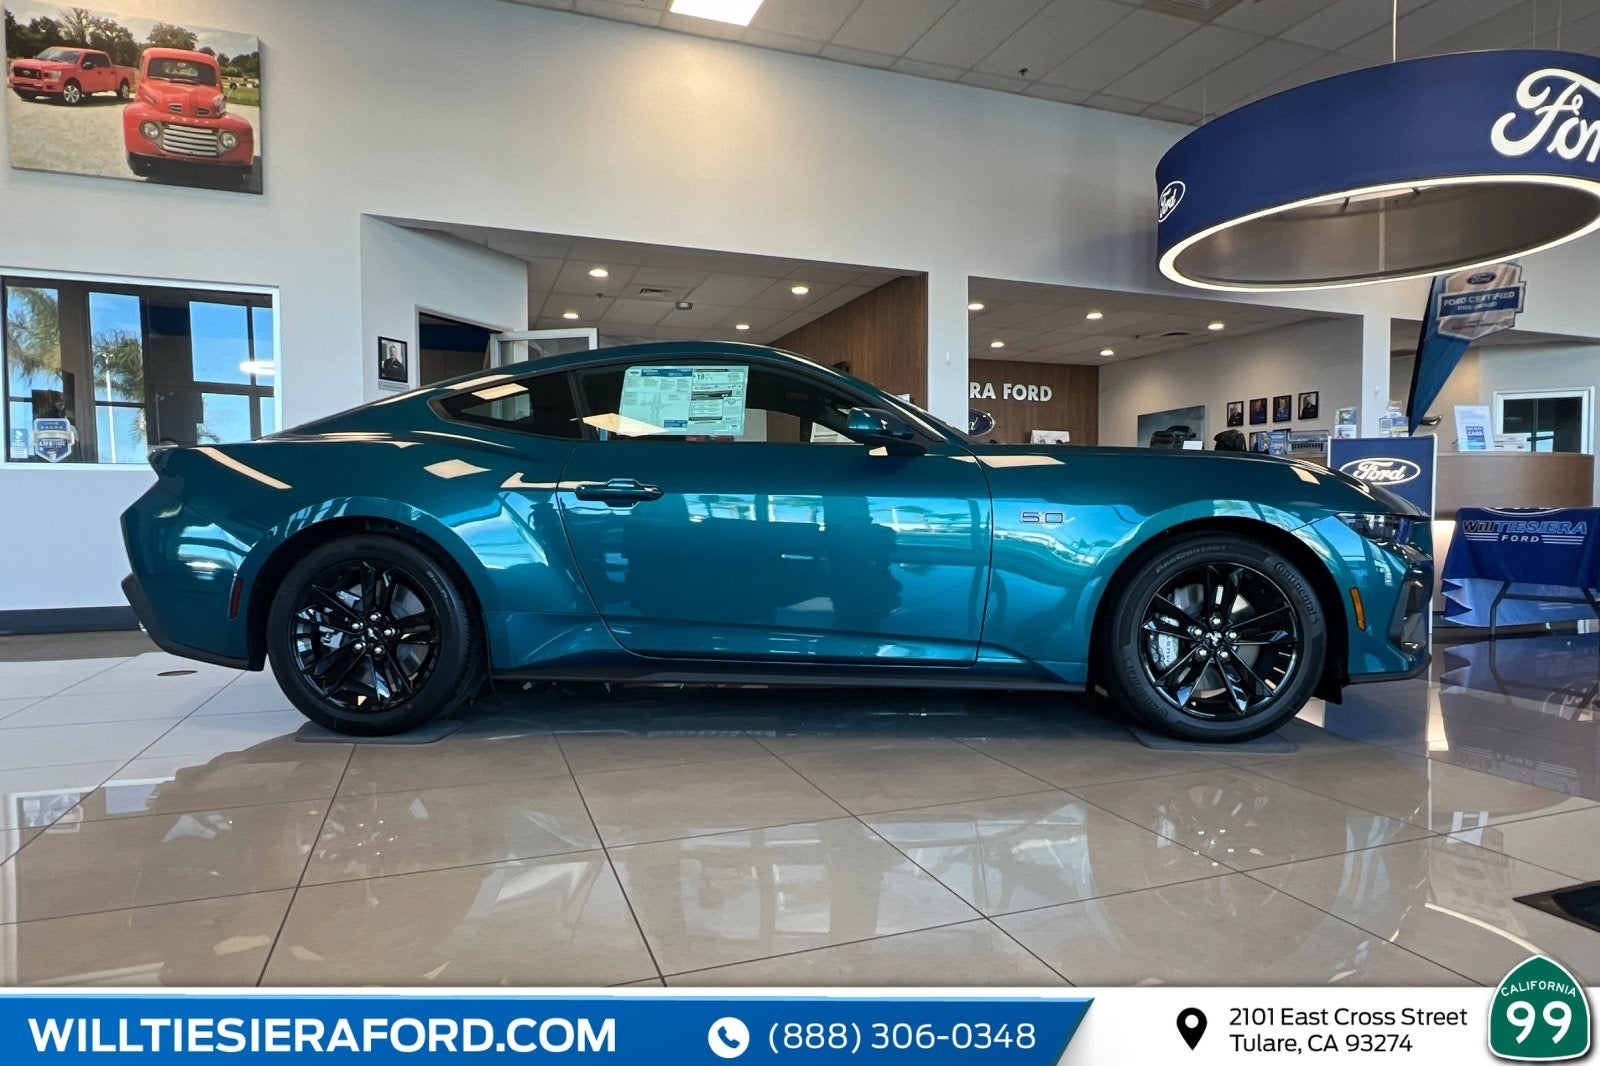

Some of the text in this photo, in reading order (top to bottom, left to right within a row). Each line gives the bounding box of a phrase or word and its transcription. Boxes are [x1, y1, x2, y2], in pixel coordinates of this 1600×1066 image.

[1002, 383, 1053, 402] FORD
[1352, 459, 1407, 482] Ford
[1501, 534, 1540, 543] FORD
